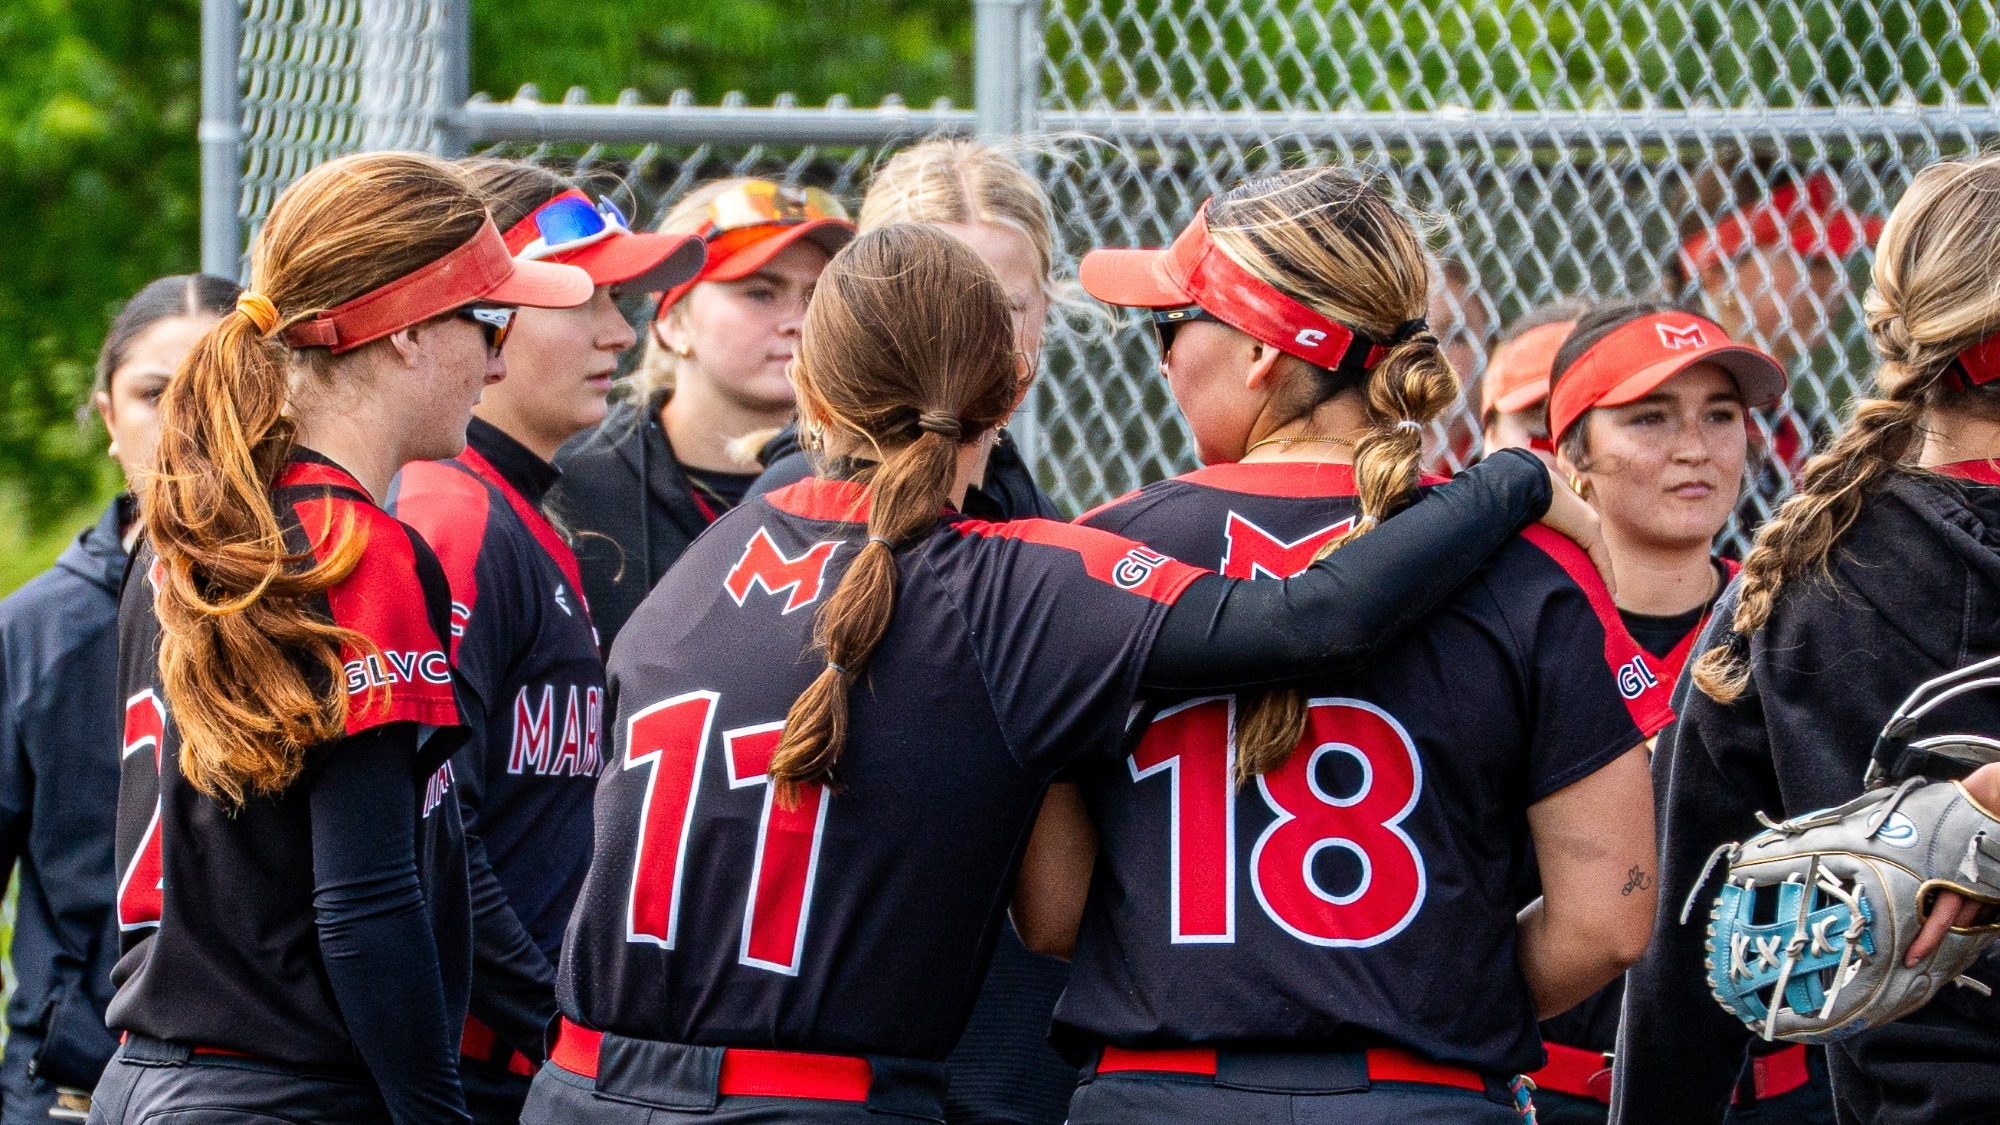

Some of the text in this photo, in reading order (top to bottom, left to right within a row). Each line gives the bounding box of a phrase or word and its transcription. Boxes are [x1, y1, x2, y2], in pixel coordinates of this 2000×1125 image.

[1655, 322, 1708, 350] M
[723, 525, 847, 616] M
[1111, 545, 1177, 590] GL
[343, 650, 452, 695] GLVC
[507, 684, 604, 778] MAR
[623, 689, 831, 977] 11
[1124, 693, 1427, 948] 18
